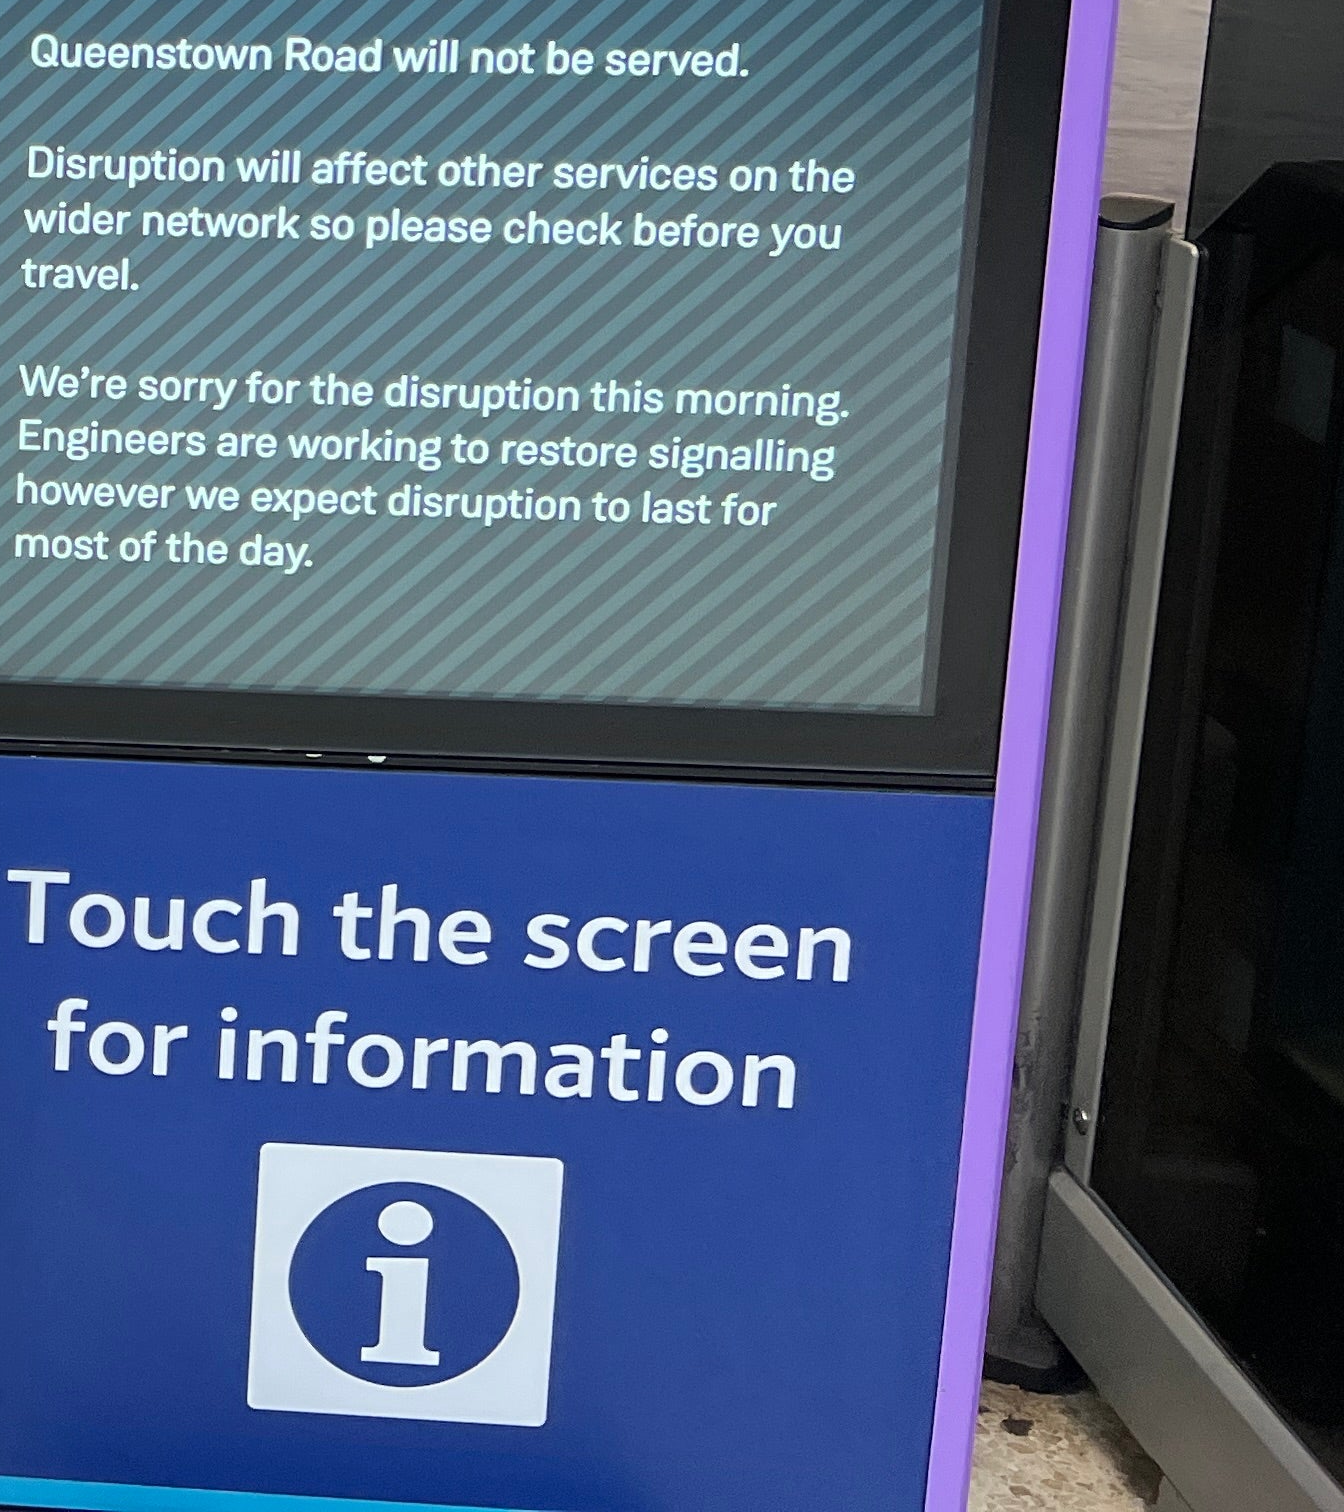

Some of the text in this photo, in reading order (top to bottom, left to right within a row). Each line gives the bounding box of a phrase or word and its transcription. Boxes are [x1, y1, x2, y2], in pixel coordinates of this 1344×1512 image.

[32, 34, 748, 76] Queenstown Road will not be served.
[29, 146, 854, 192] Disruption will affect other services on the
[24, 202, 841, 256] wider network so please check before you
[21, 258, 138, 290] travel.
[20, 365, 848, 425] We’re sorry for the disruption this morning.
[20, 419, 834, 481] Engineers are working to restore signalling
[17, 473, 777, 526] however we expect disruption to last for
[16, 531, 312, 574] most of the day.
[8, 870, 850, 981] Touch the screen
[48, 999, 795, 1108] for information
